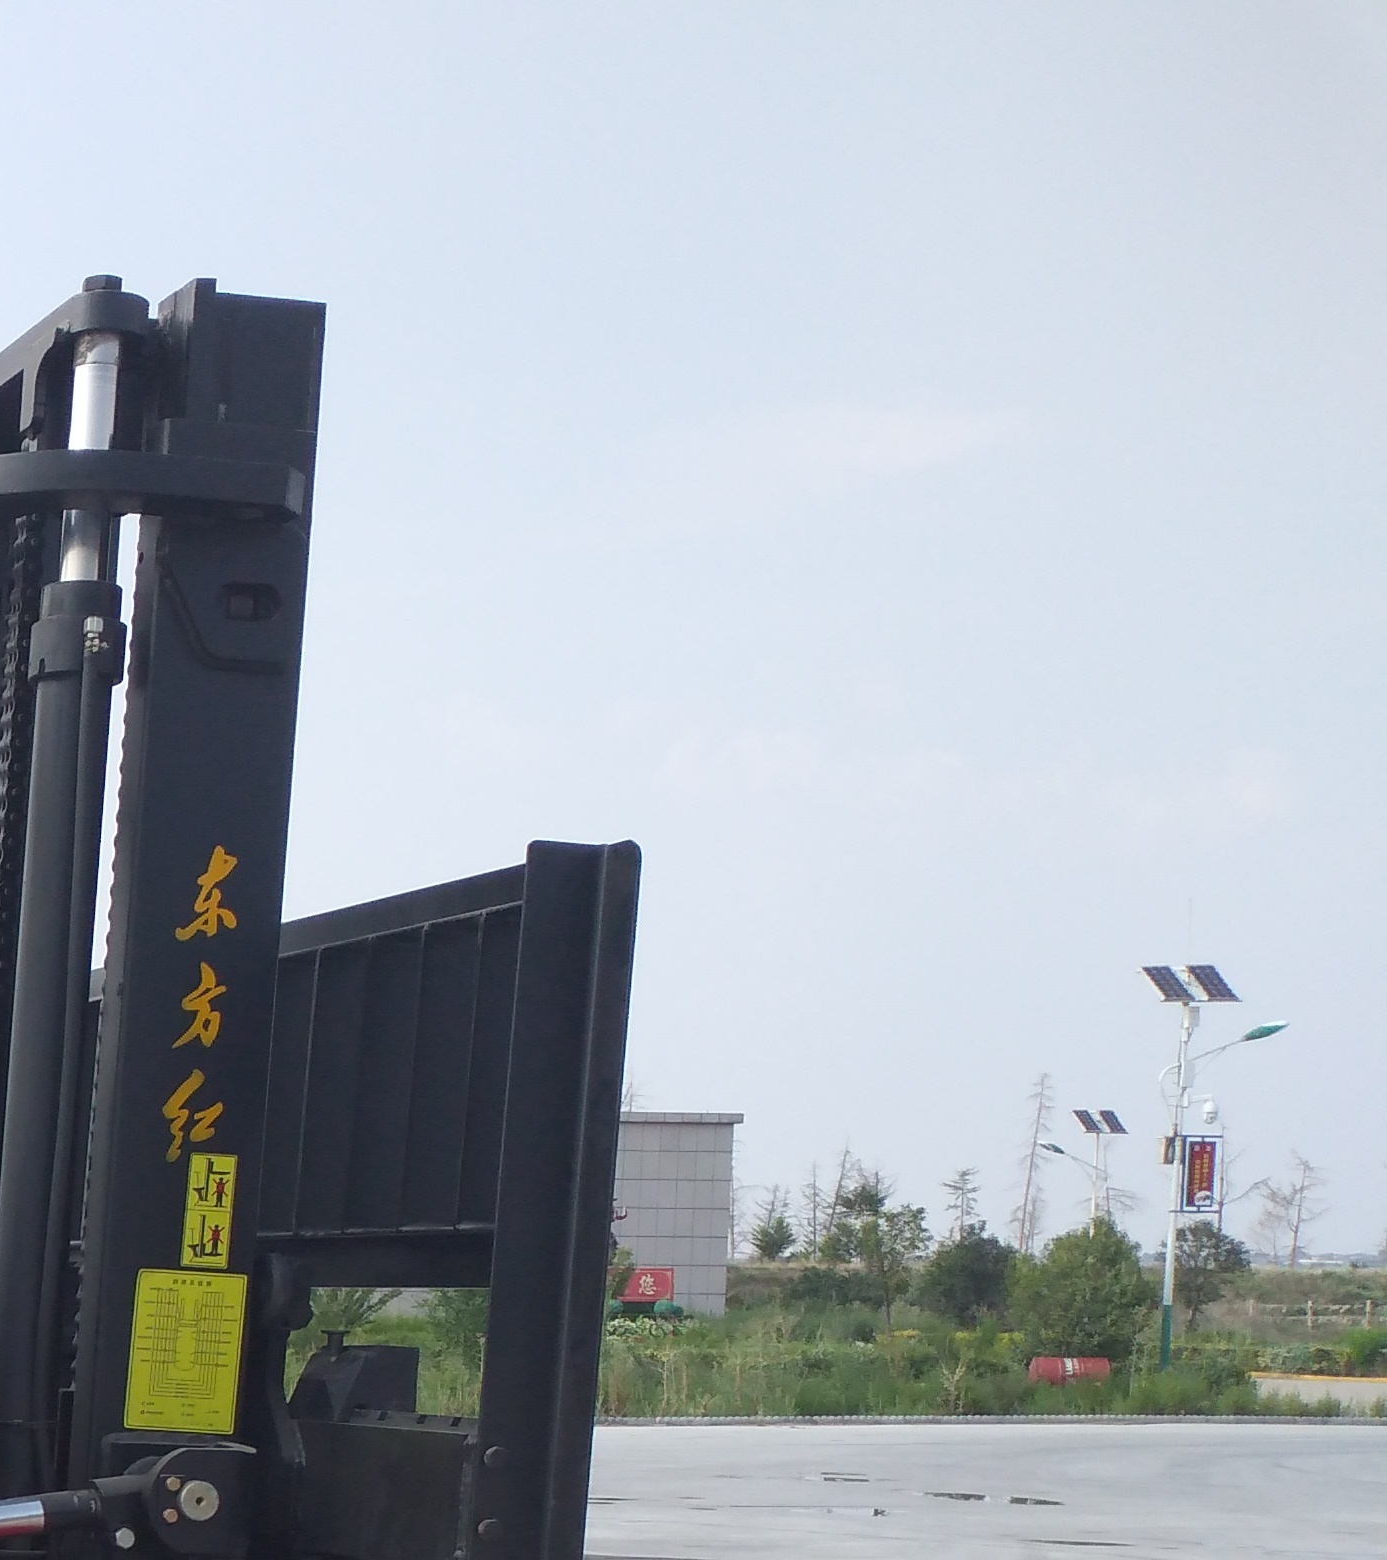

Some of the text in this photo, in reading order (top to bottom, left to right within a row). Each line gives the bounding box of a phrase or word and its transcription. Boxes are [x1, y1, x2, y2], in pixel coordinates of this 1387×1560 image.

[162, 845, 238, 1163] 东方红
[638, 1273, 657, 1296] 您
